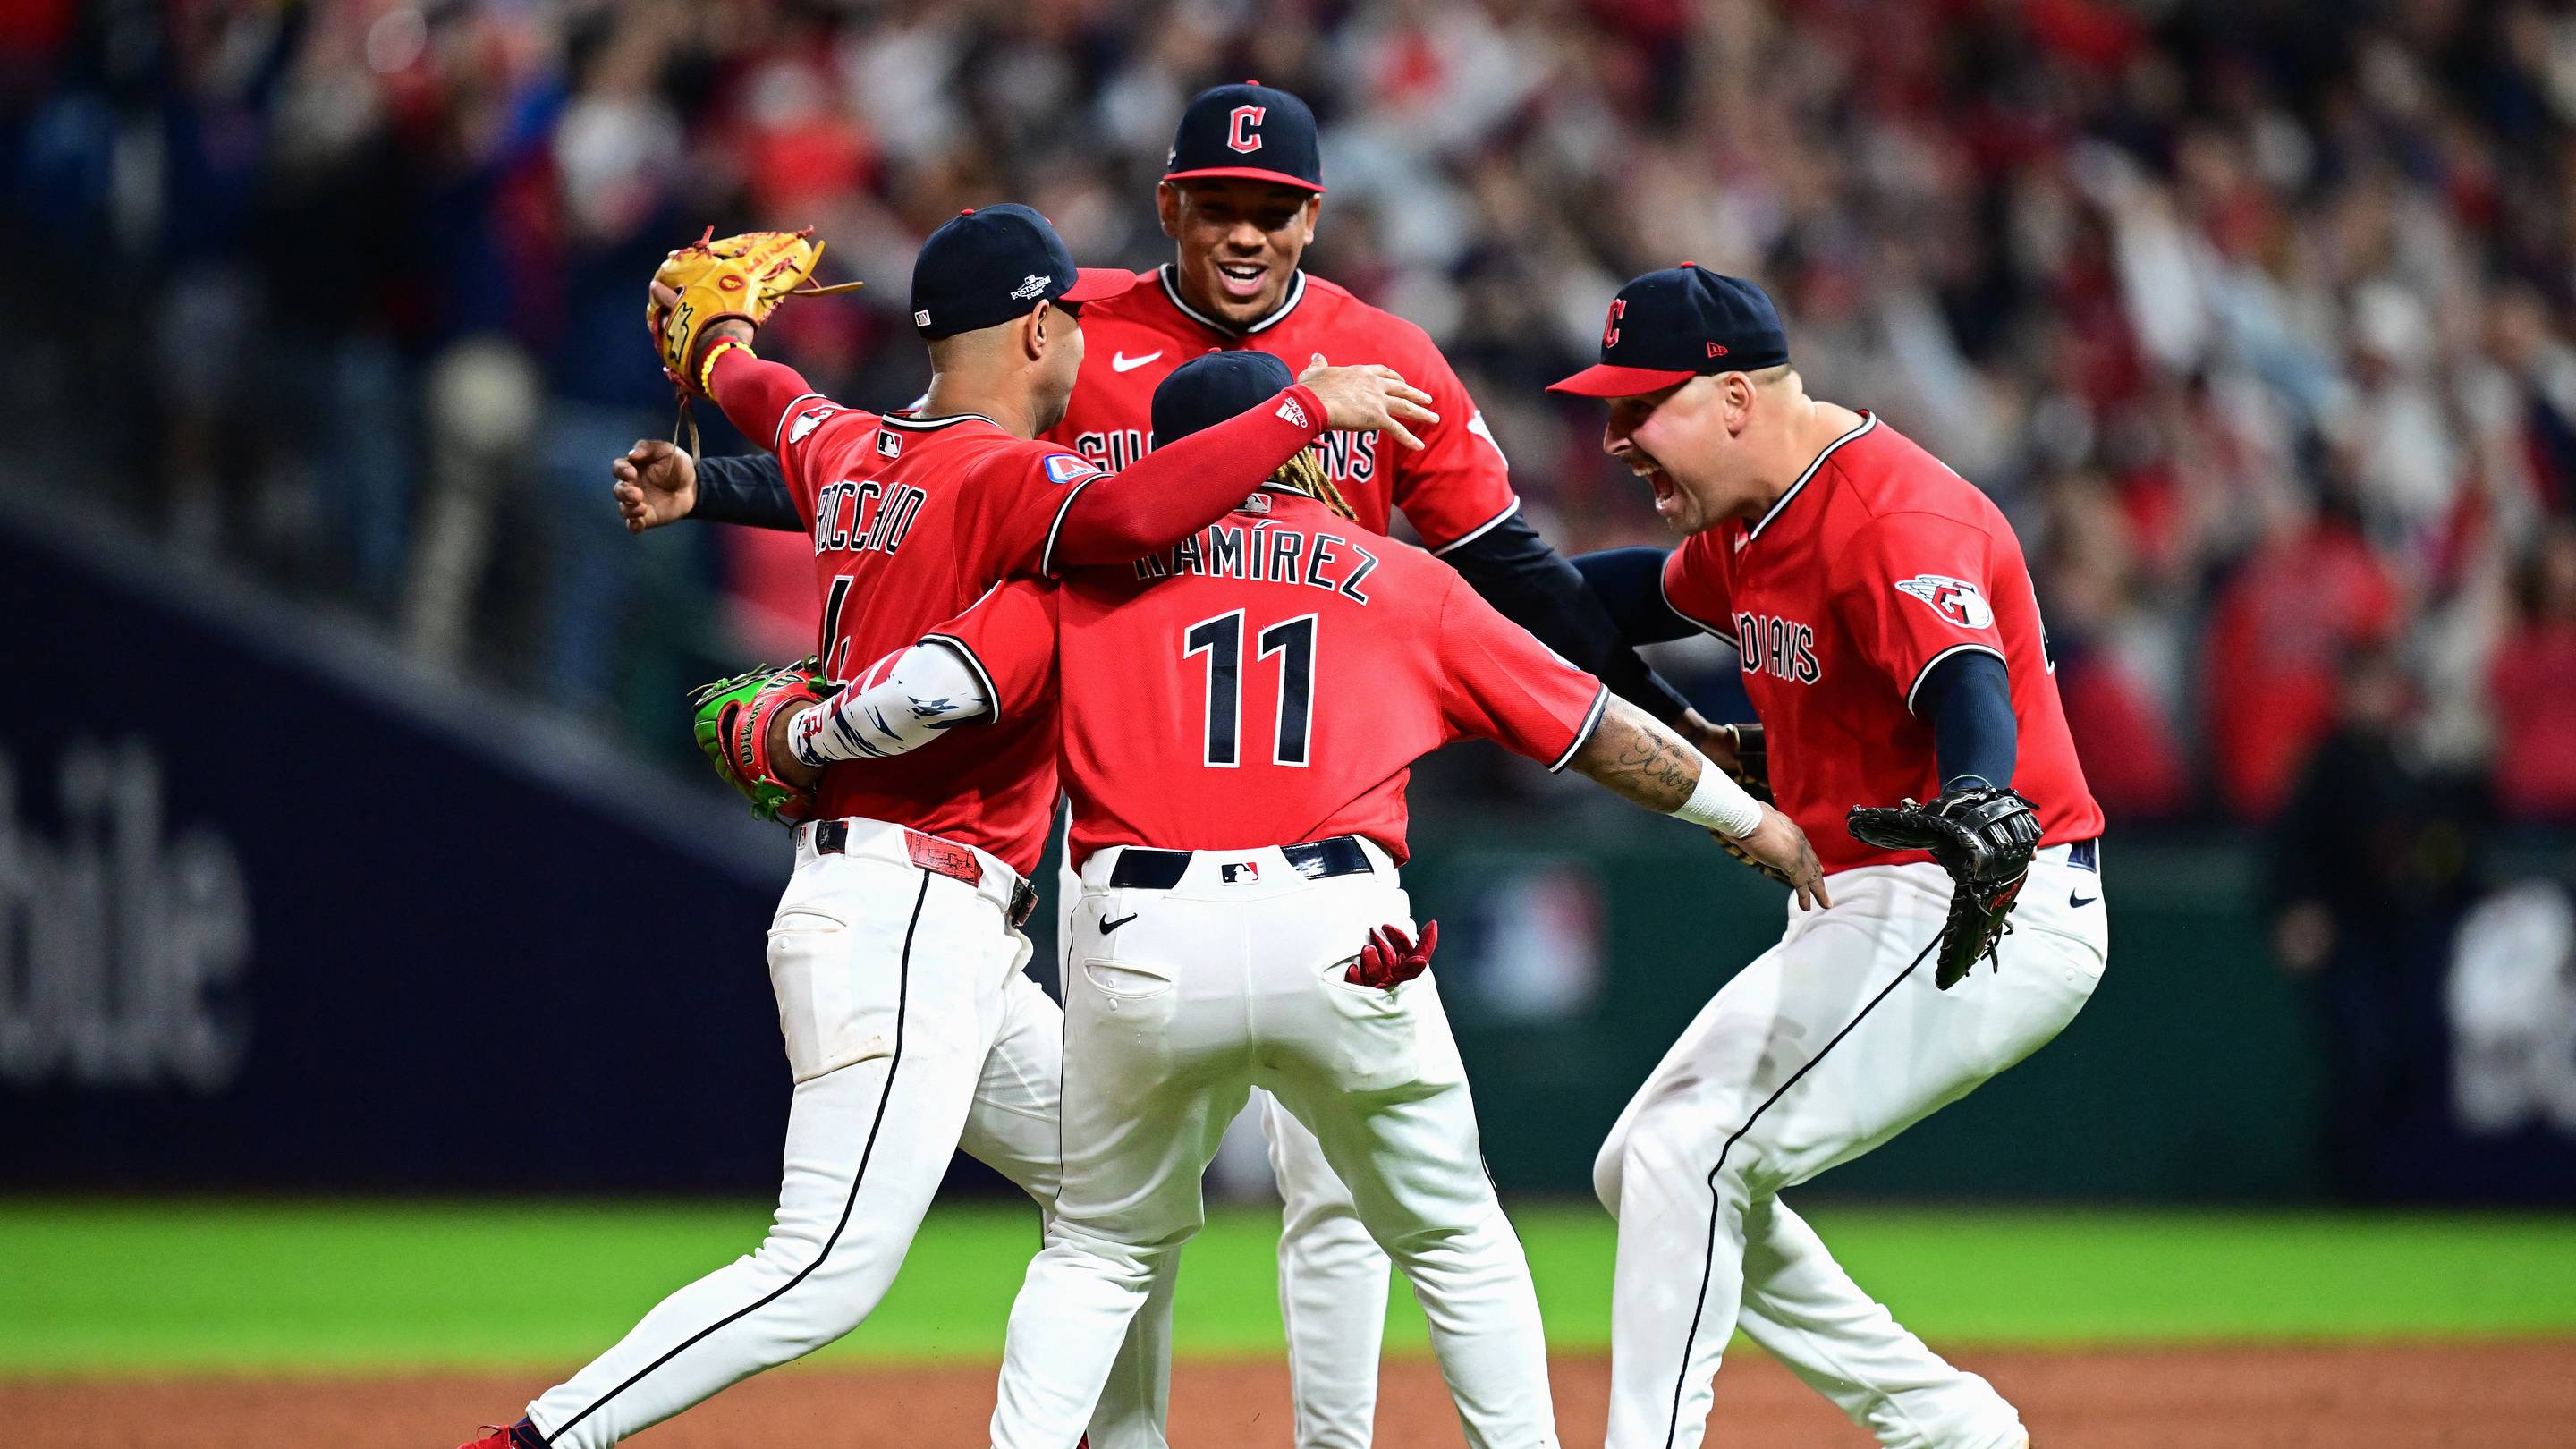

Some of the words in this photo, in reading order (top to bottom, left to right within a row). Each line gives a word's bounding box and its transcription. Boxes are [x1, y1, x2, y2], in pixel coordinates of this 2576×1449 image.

[1226, 104, 1267, 154] C
[1010, 275, 1052, 301] POSTSEASON
[1603, 298, 1628, 349] C
[1284, 396, 1309, 428] adidas
[1731, 610, 1822, 686] DIANS
[1182, 607, 1319, 768] 11
[740, 699, 767, 768] Wilson
